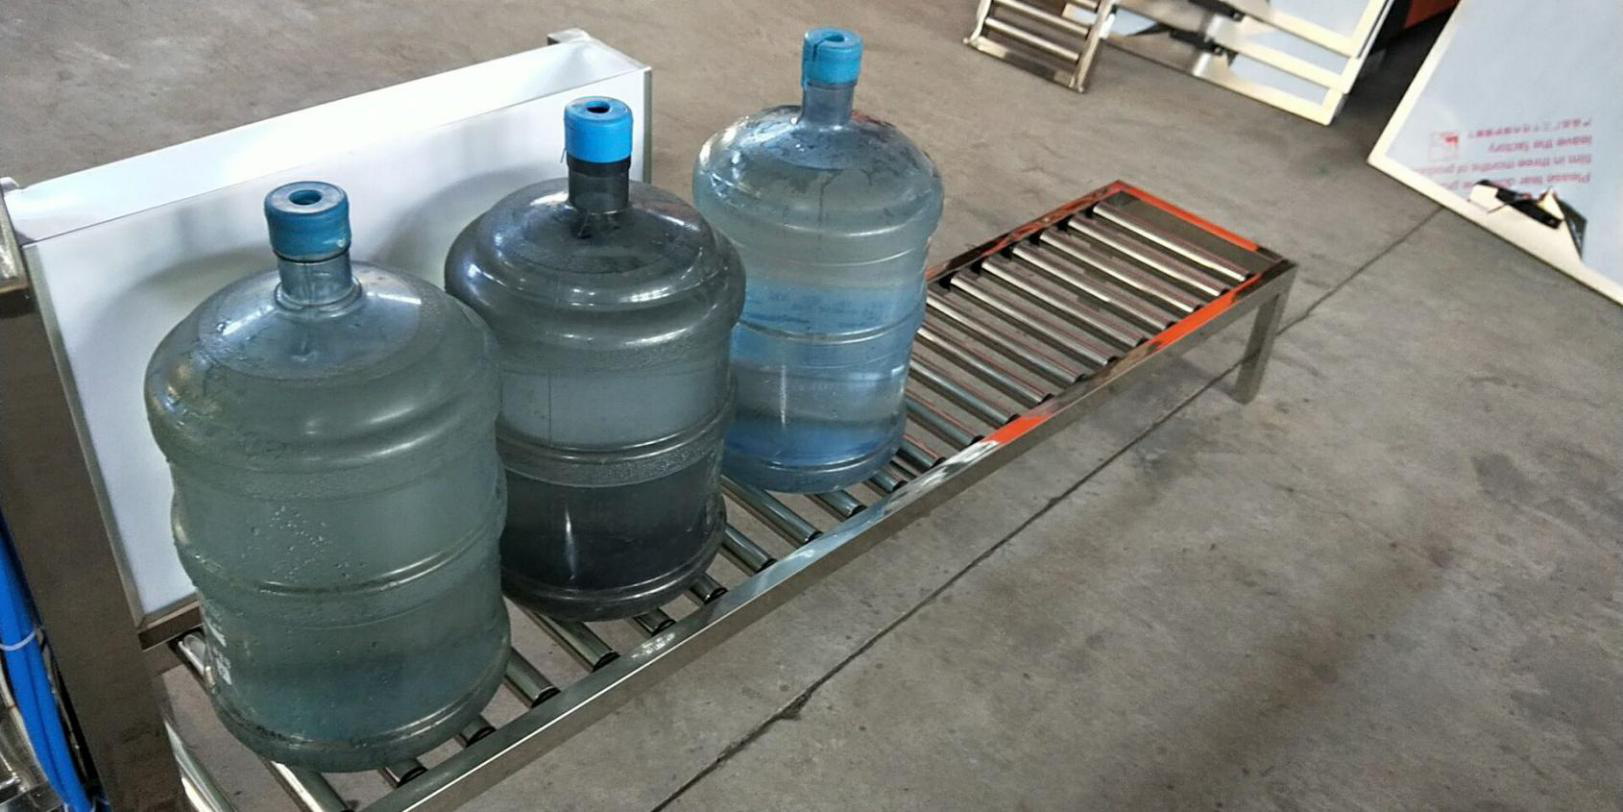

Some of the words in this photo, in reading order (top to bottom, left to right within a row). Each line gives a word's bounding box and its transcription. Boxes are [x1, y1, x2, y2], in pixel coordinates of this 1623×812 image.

[1533, 139, 1553, 149] the
[1557, 135, 1592, 146] leave
[1488, 141, 1530, 153] factory
[1518, 157, 1550, 167] three
[1553, 155, 1566, 165] in
[1568, 154, 1592, 164] film
[1457, 164, 1468, 173] of
[1472, 160, 1515, 171] months
[1546, 173, 1591, 184] Please
